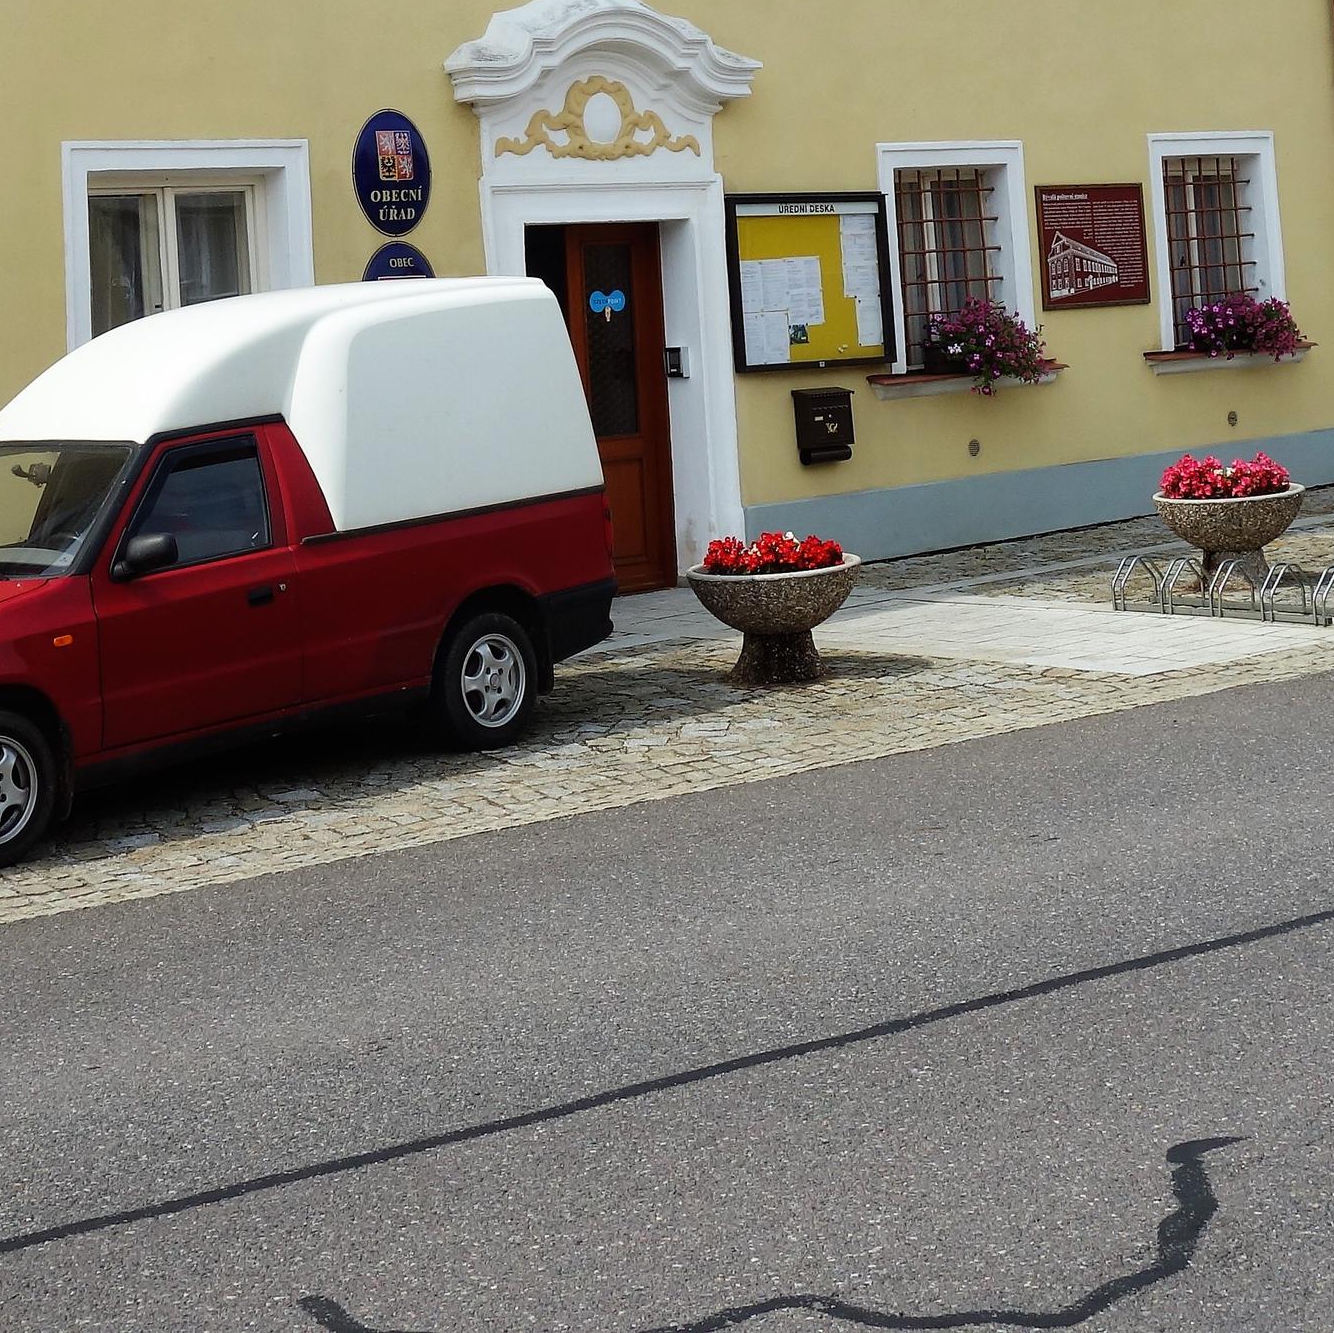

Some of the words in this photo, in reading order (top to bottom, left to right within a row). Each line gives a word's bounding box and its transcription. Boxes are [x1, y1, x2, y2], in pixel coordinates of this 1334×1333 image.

[370, 185, 422, 203] OBECNÍ
[379, 205, 416, 221] ÚŘAD
[809, 204, 835, 213] DESKA
[389, 257, 415, 268] OBEC
